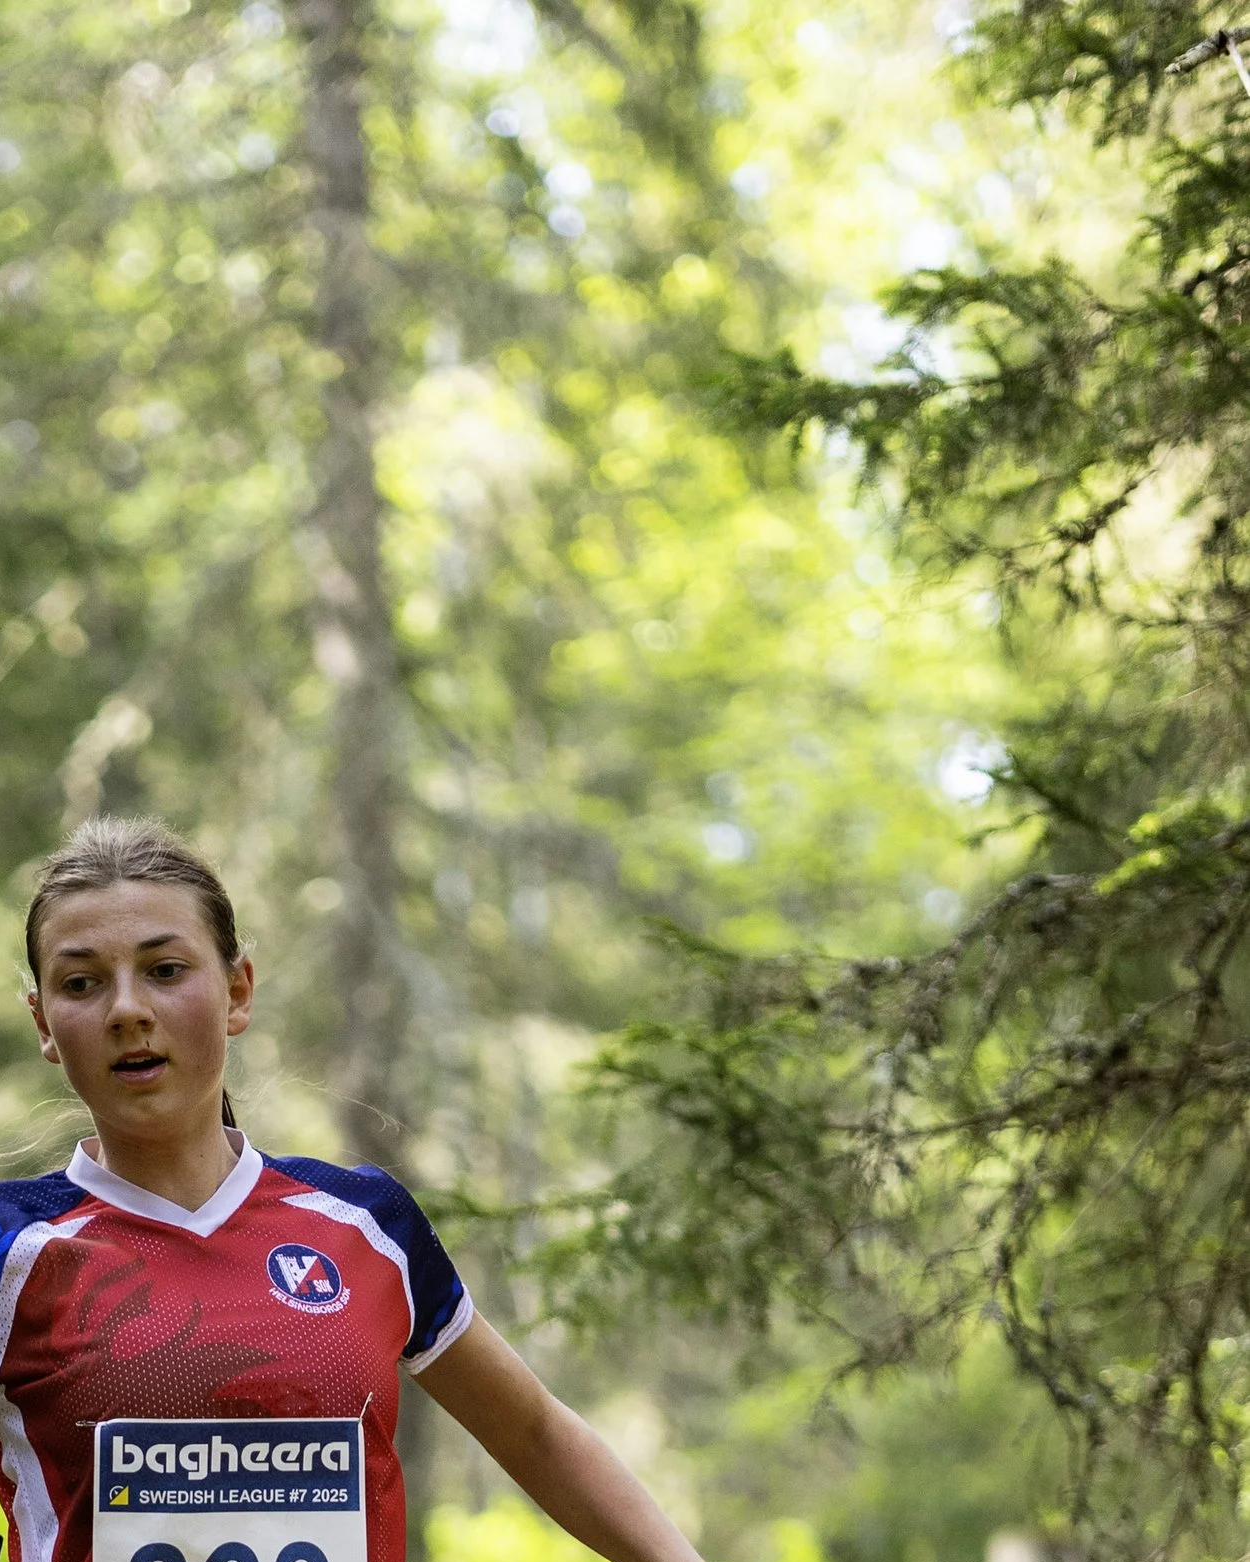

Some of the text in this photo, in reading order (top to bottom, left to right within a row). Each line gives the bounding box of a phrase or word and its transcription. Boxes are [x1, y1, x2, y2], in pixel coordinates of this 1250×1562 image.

[112, 1436, 350, 1481] bagheera
[139, 1488, 349, 1505] SWEDISH LEAGUE #7 2025
